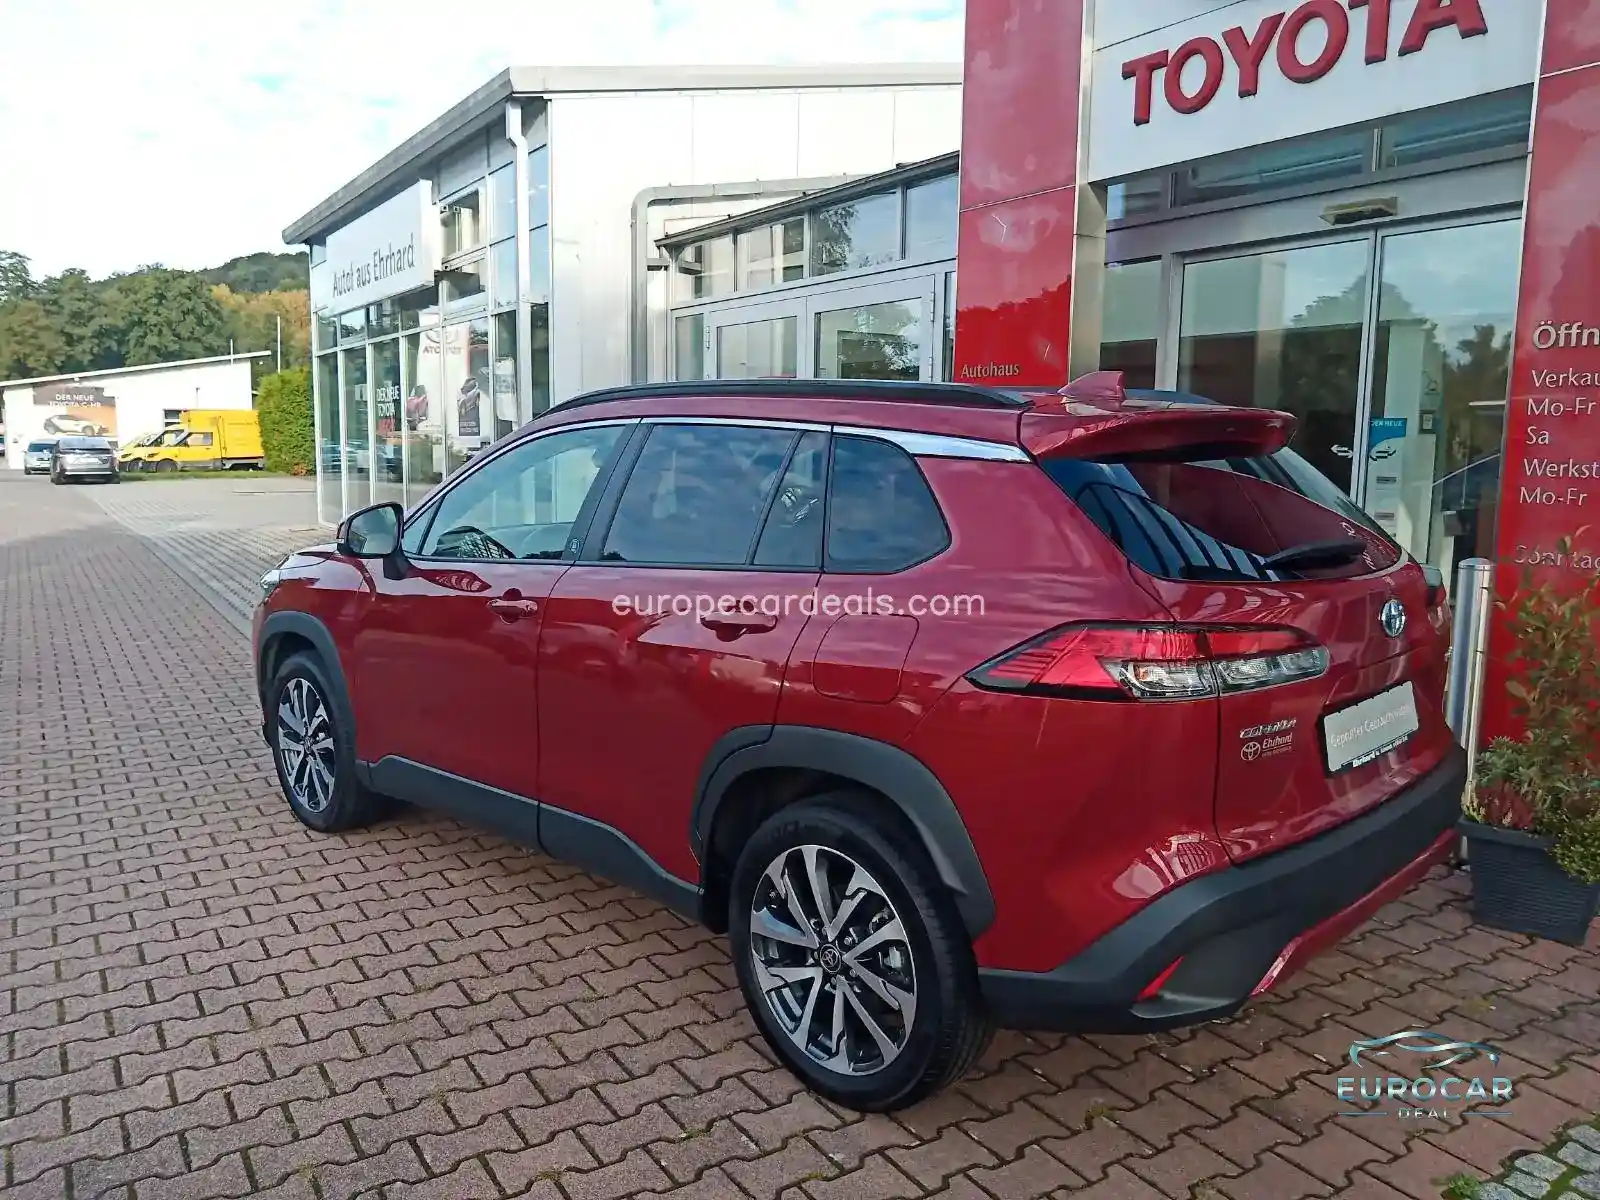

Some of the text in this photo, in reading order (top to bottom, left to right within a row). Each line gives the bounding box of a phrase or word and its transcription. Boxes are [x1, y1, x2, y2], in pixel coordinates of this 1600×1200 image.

[1122, 0, 1488, 126] TOYOTA
[373, 232, 415, 281] Ehrhard
[960, 361, 1019, 378] Autohaus
[73, 394, 94, 402] NEUE
[1527, 397, 1597, 416] Mo-Fr
[1525, 425, 1549, 445] Sa
[1523, 458, 1600, 479] Werkst
[1519, 486, 1588, 506] Mo-Fr
